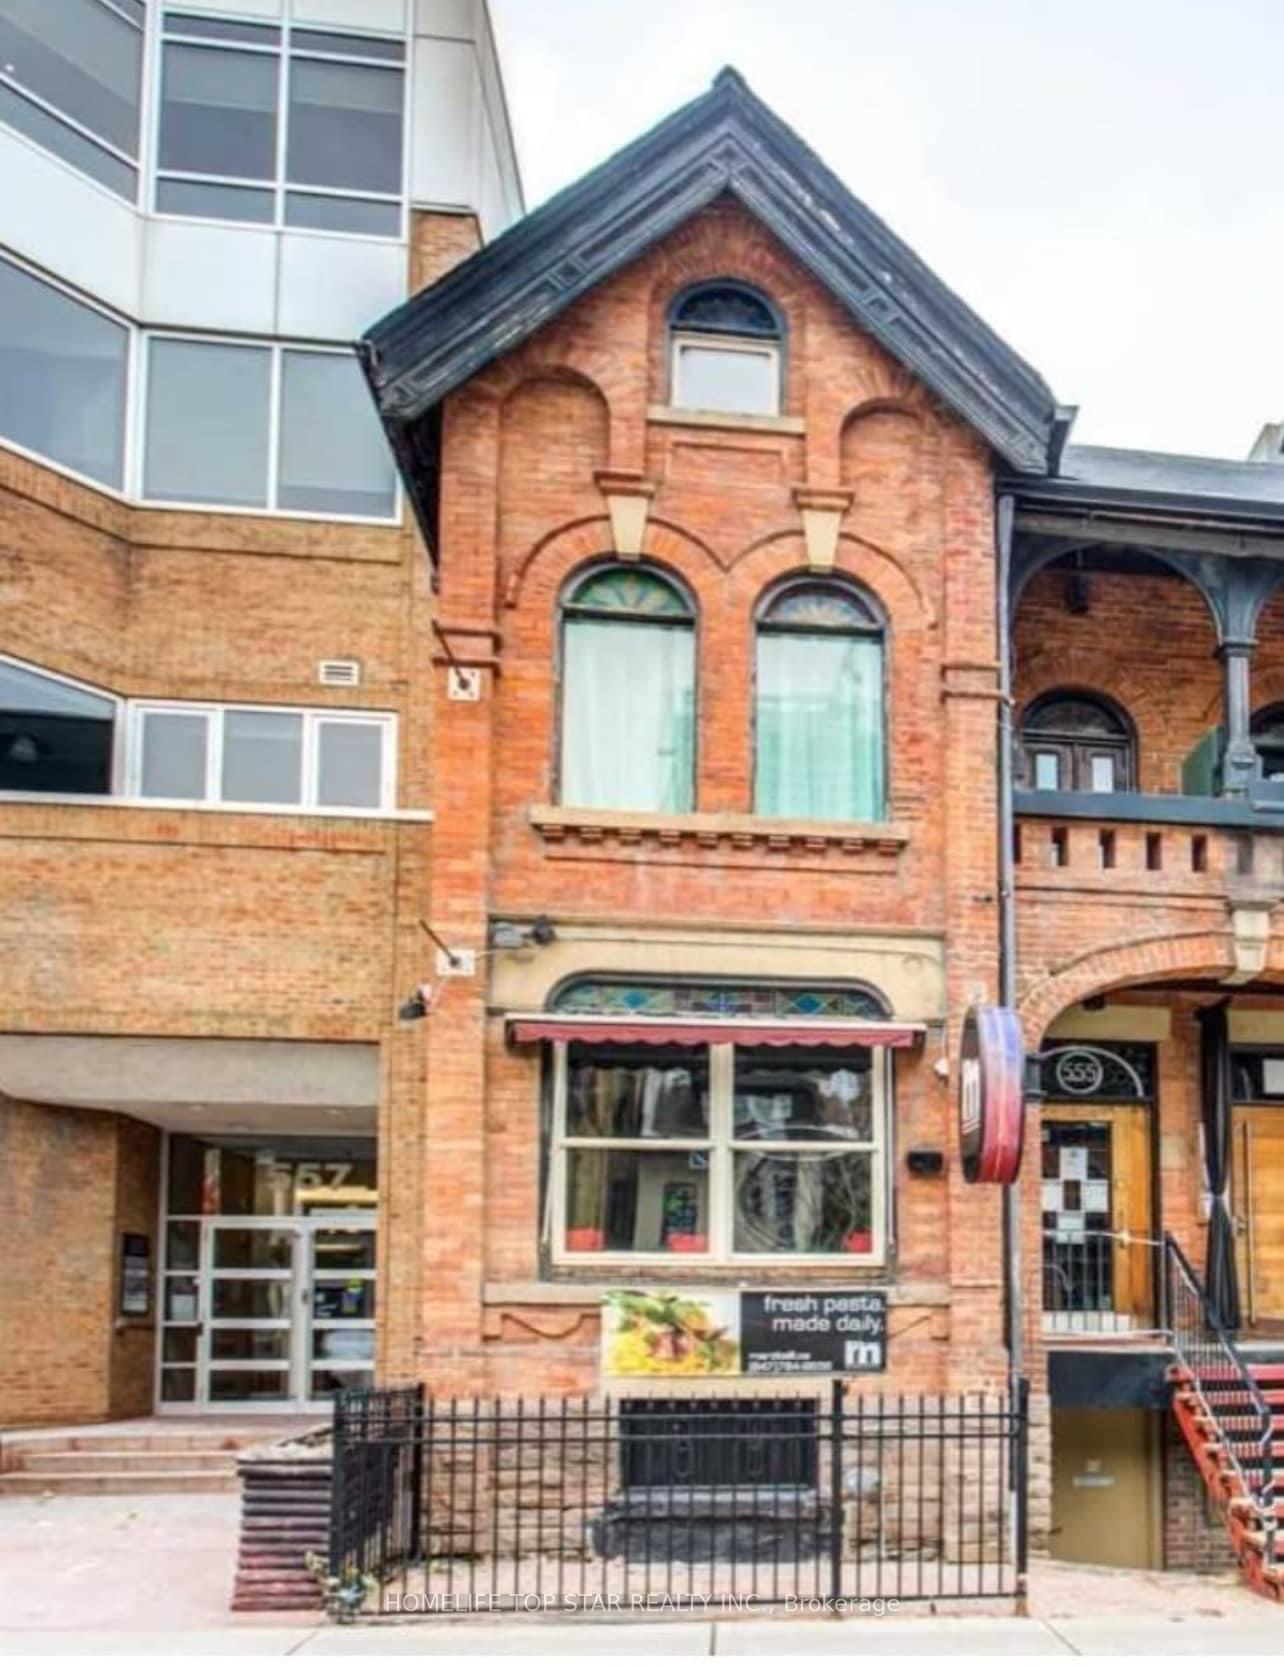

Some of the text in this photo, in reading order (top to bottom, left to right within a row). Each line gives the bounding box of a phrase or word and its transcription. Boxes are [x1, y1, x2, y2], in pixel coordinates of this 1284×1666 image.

[1062, 1063, 1097, 1082] 555
[763, 1295, 818, 1313] fresh
[771, 1314, 884, 1335] made daily.
